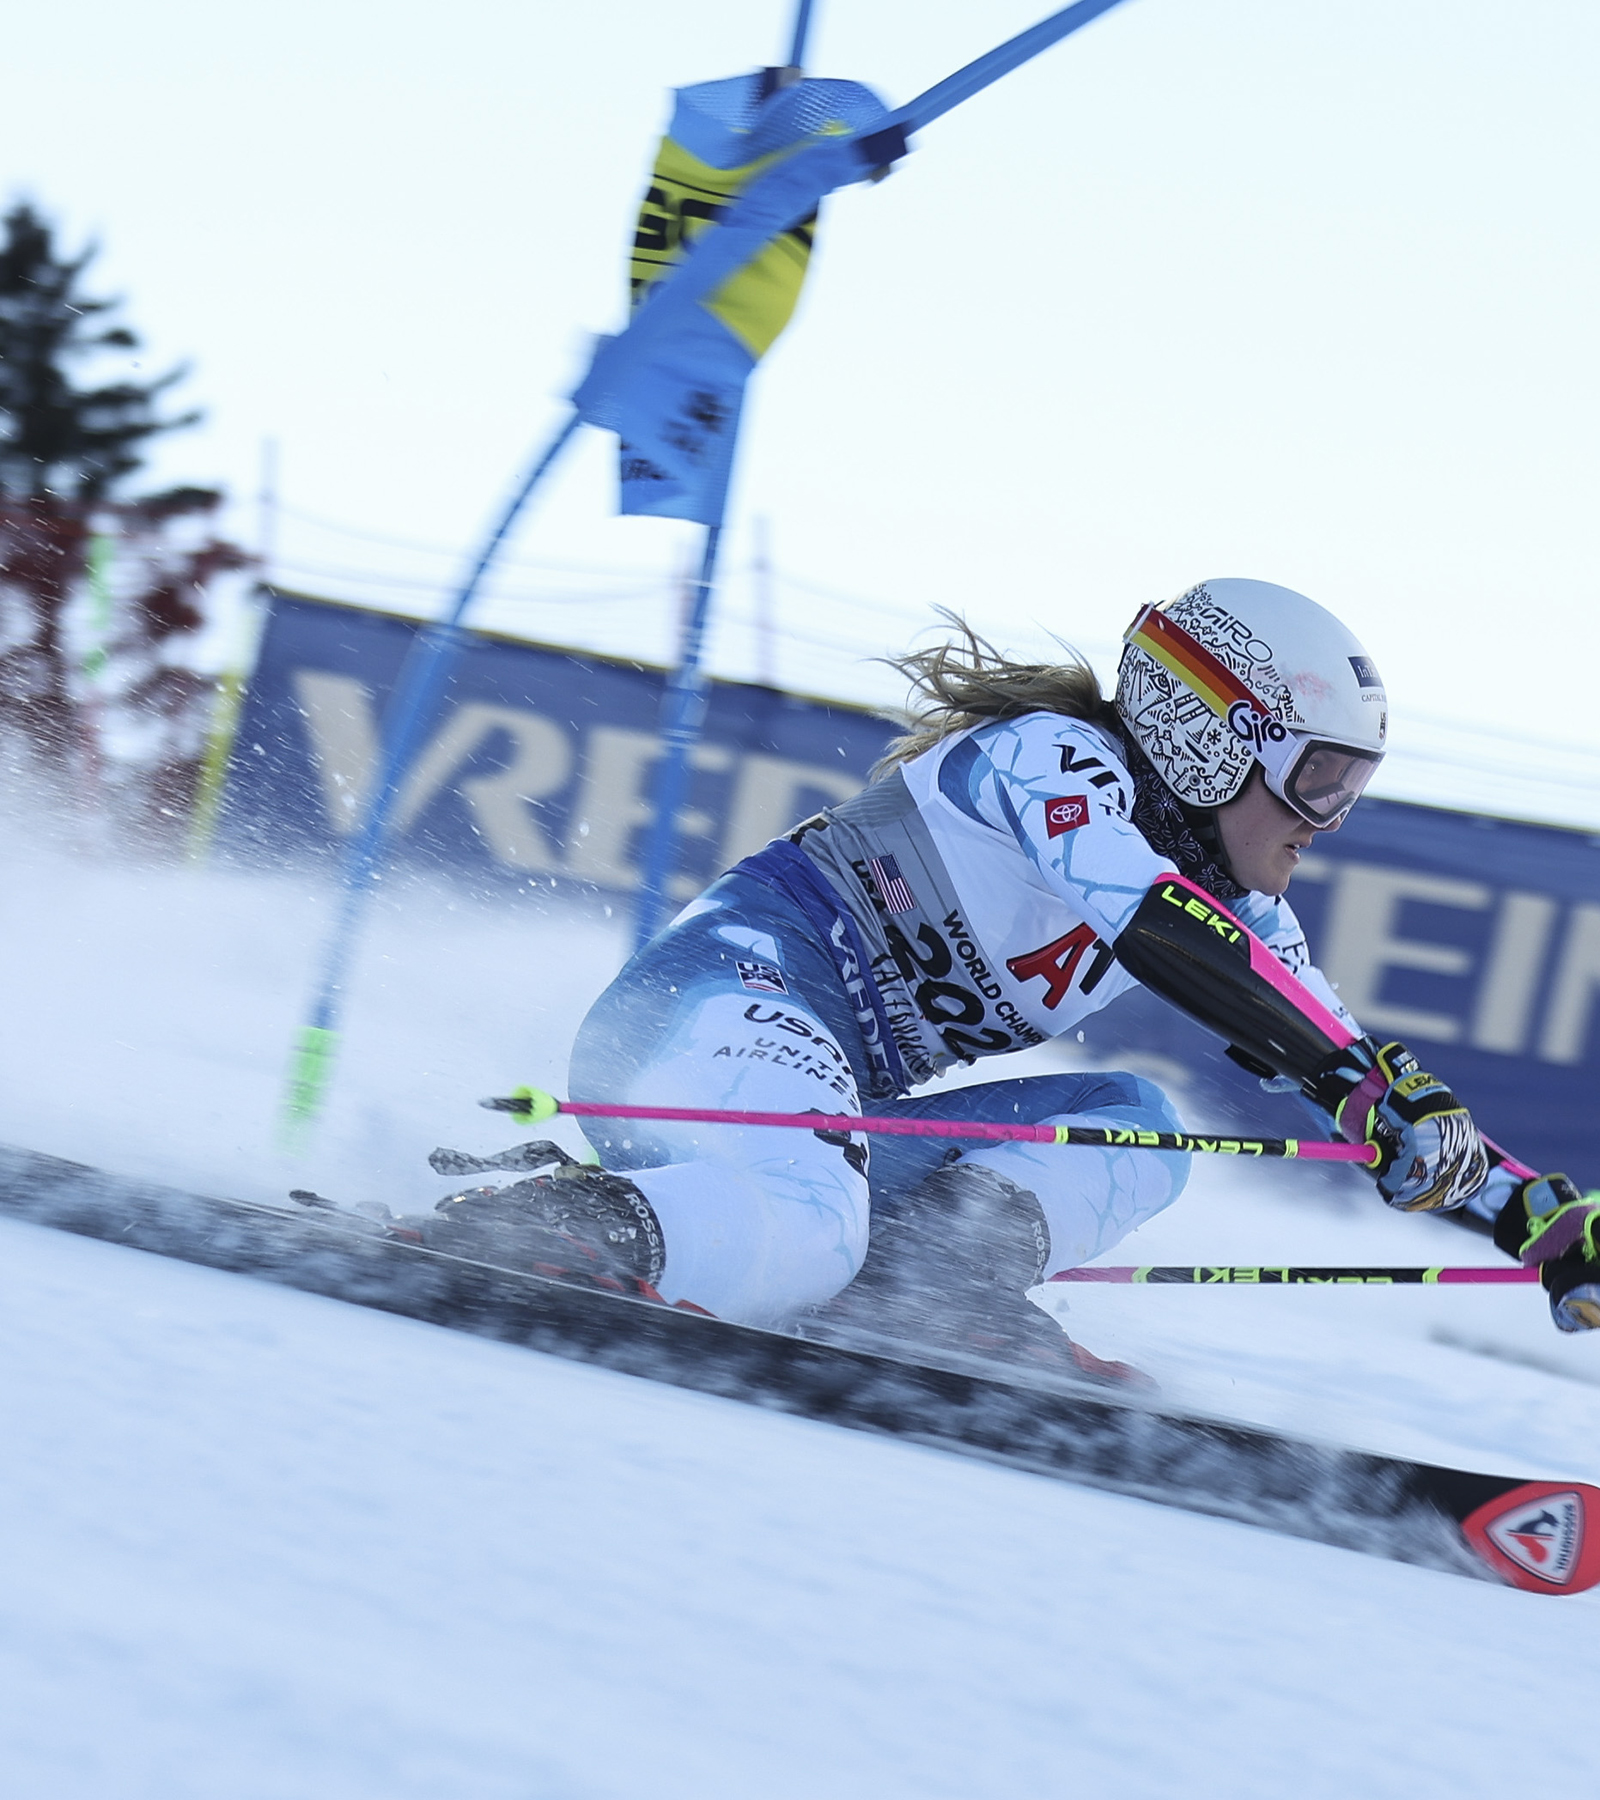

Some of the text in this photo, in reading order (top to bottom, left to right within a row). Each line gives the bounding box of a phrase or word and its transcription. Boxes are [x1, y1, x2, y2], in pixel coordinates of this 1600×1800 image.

[1199, 606, 1273, 663] GIRO
[1228, 701, 1288, 753] Giro
[1161, 884, 1241, 944] LEKI
[943, 908, 1002, 1000] WORLD
[883, 921, 1025, 1067] 202
